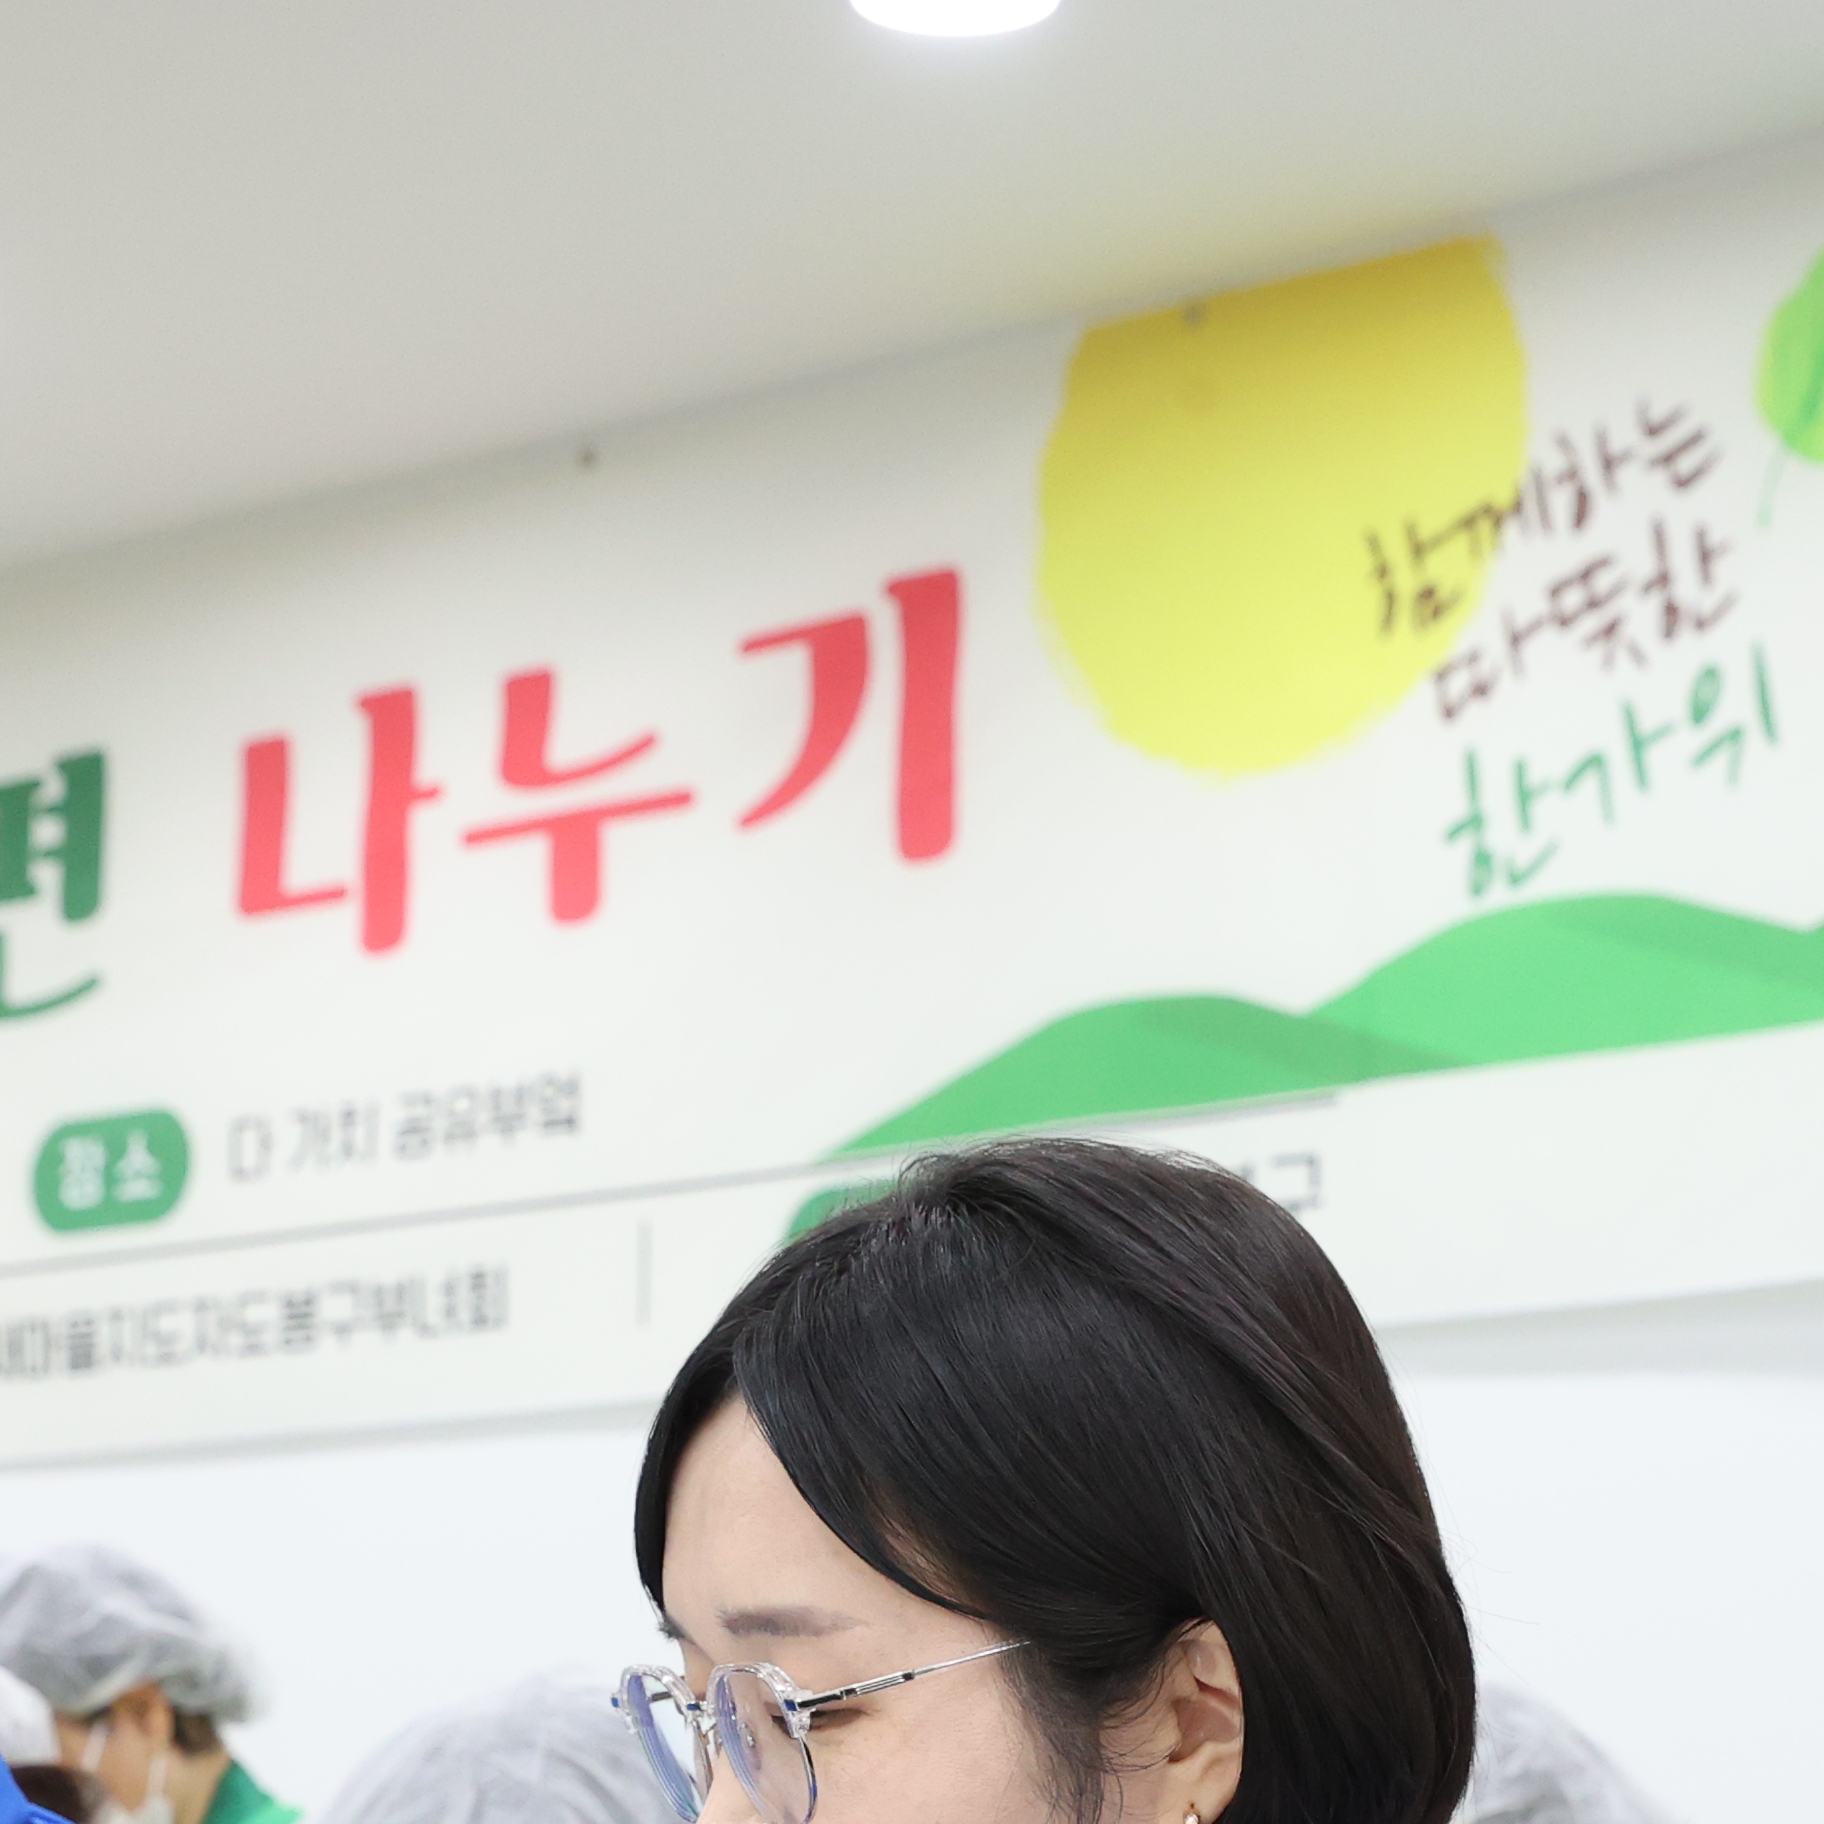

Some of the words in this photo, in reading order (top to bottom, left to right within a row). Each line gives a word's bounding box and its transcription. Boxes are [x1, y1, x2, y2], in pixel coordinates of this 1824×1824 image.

[1364, 396, 1724, 636] 함께하는
[1430, 514, 1740, 724] 따뜻한
[232, 564, 966, 958] 나누기
[1442, 640, 1780, 898] 한가위
